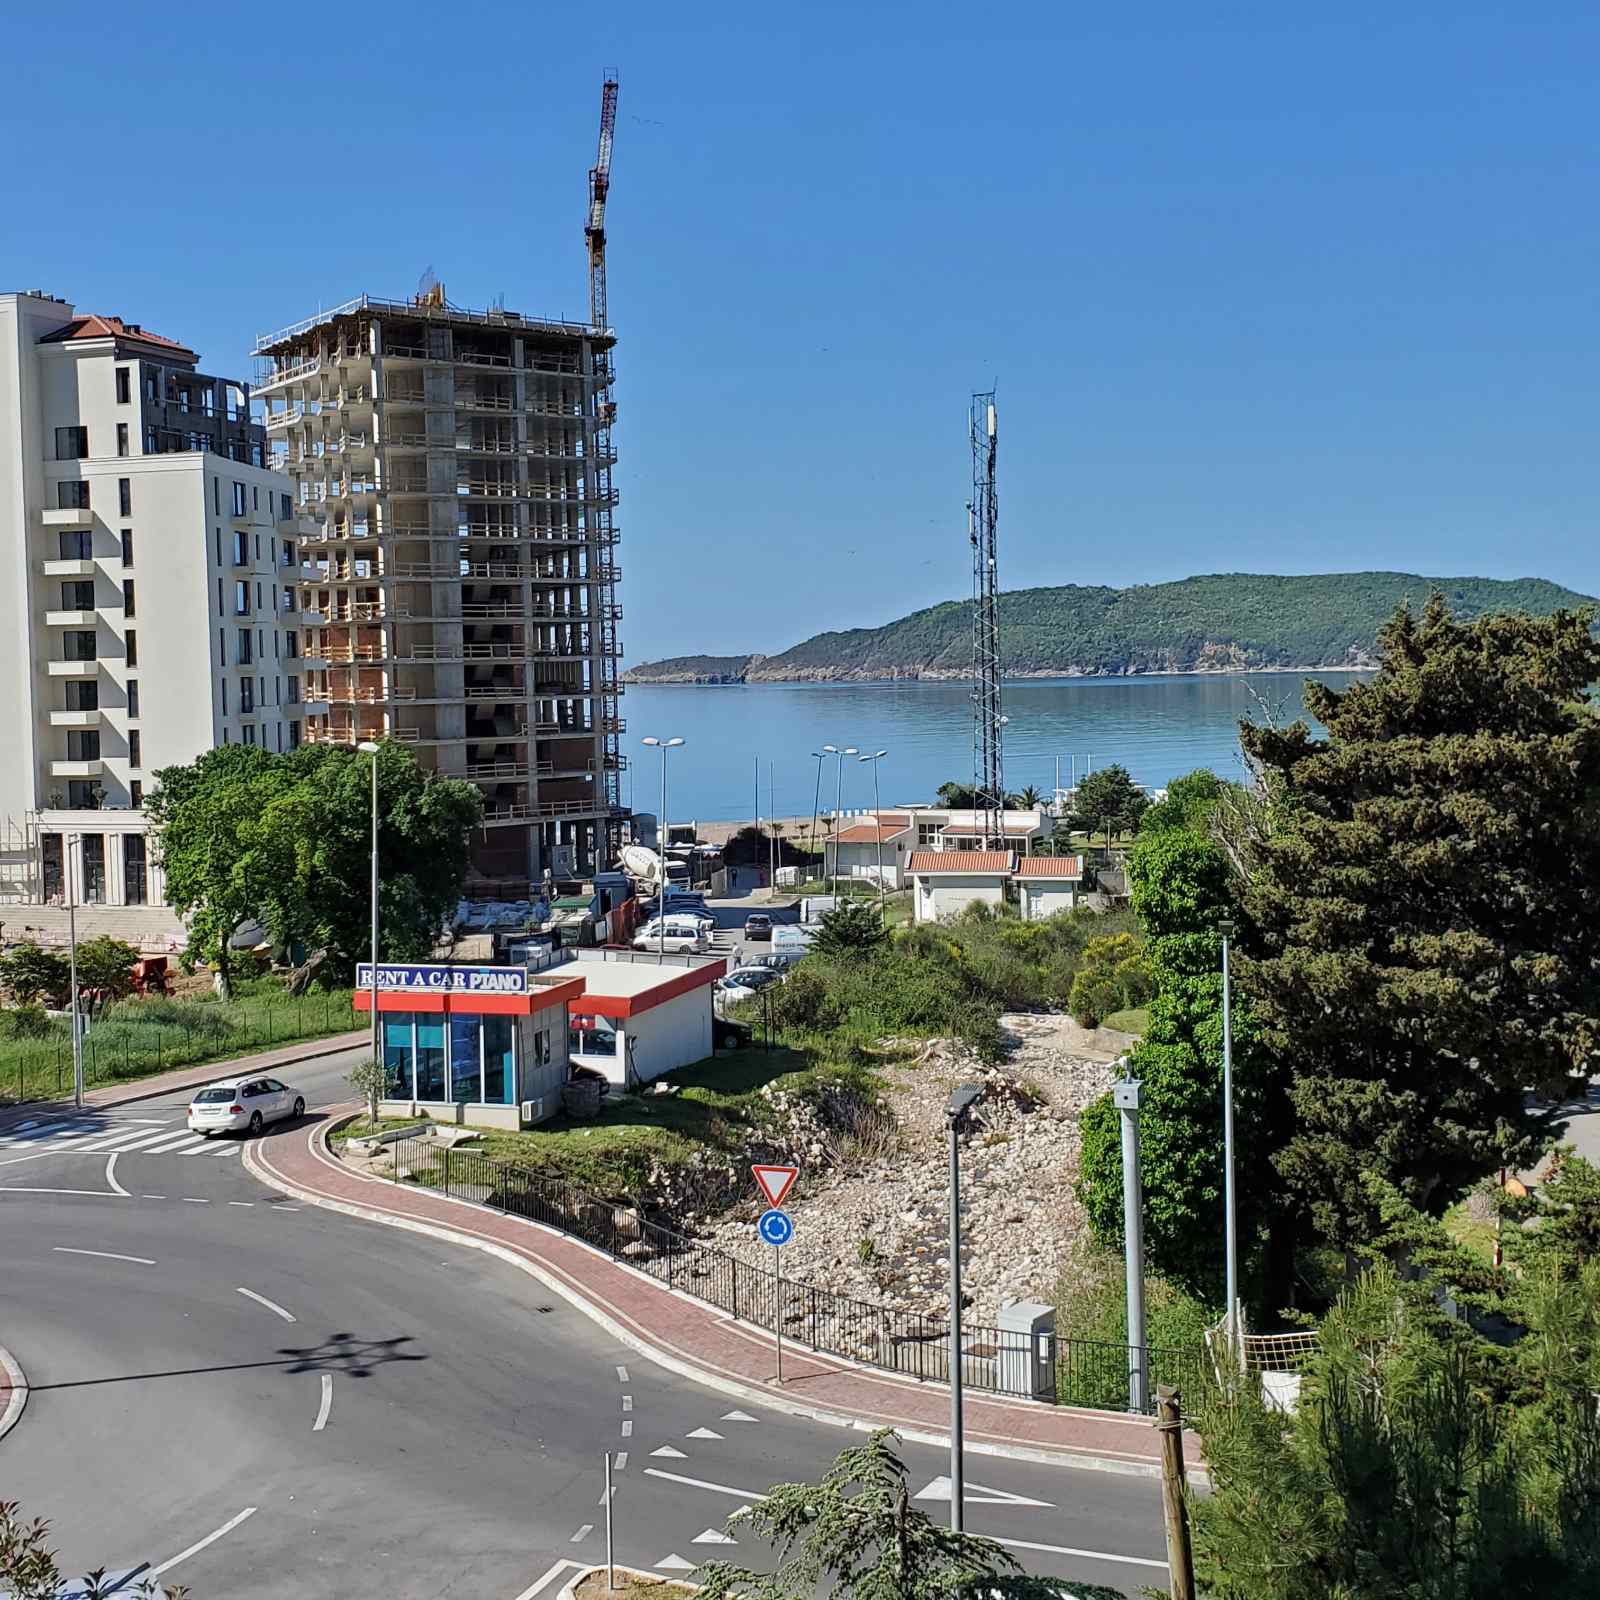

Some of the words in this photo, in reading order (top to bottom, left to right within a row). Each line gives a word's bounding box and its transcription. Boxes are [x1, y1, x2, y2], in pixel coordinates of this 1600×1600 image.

[361, 970, 409, 985] RENT
[413, 971, 426, 985] A
[429, 972, 466, 986] CAR
[470, 973, 522, 990] PIANO
